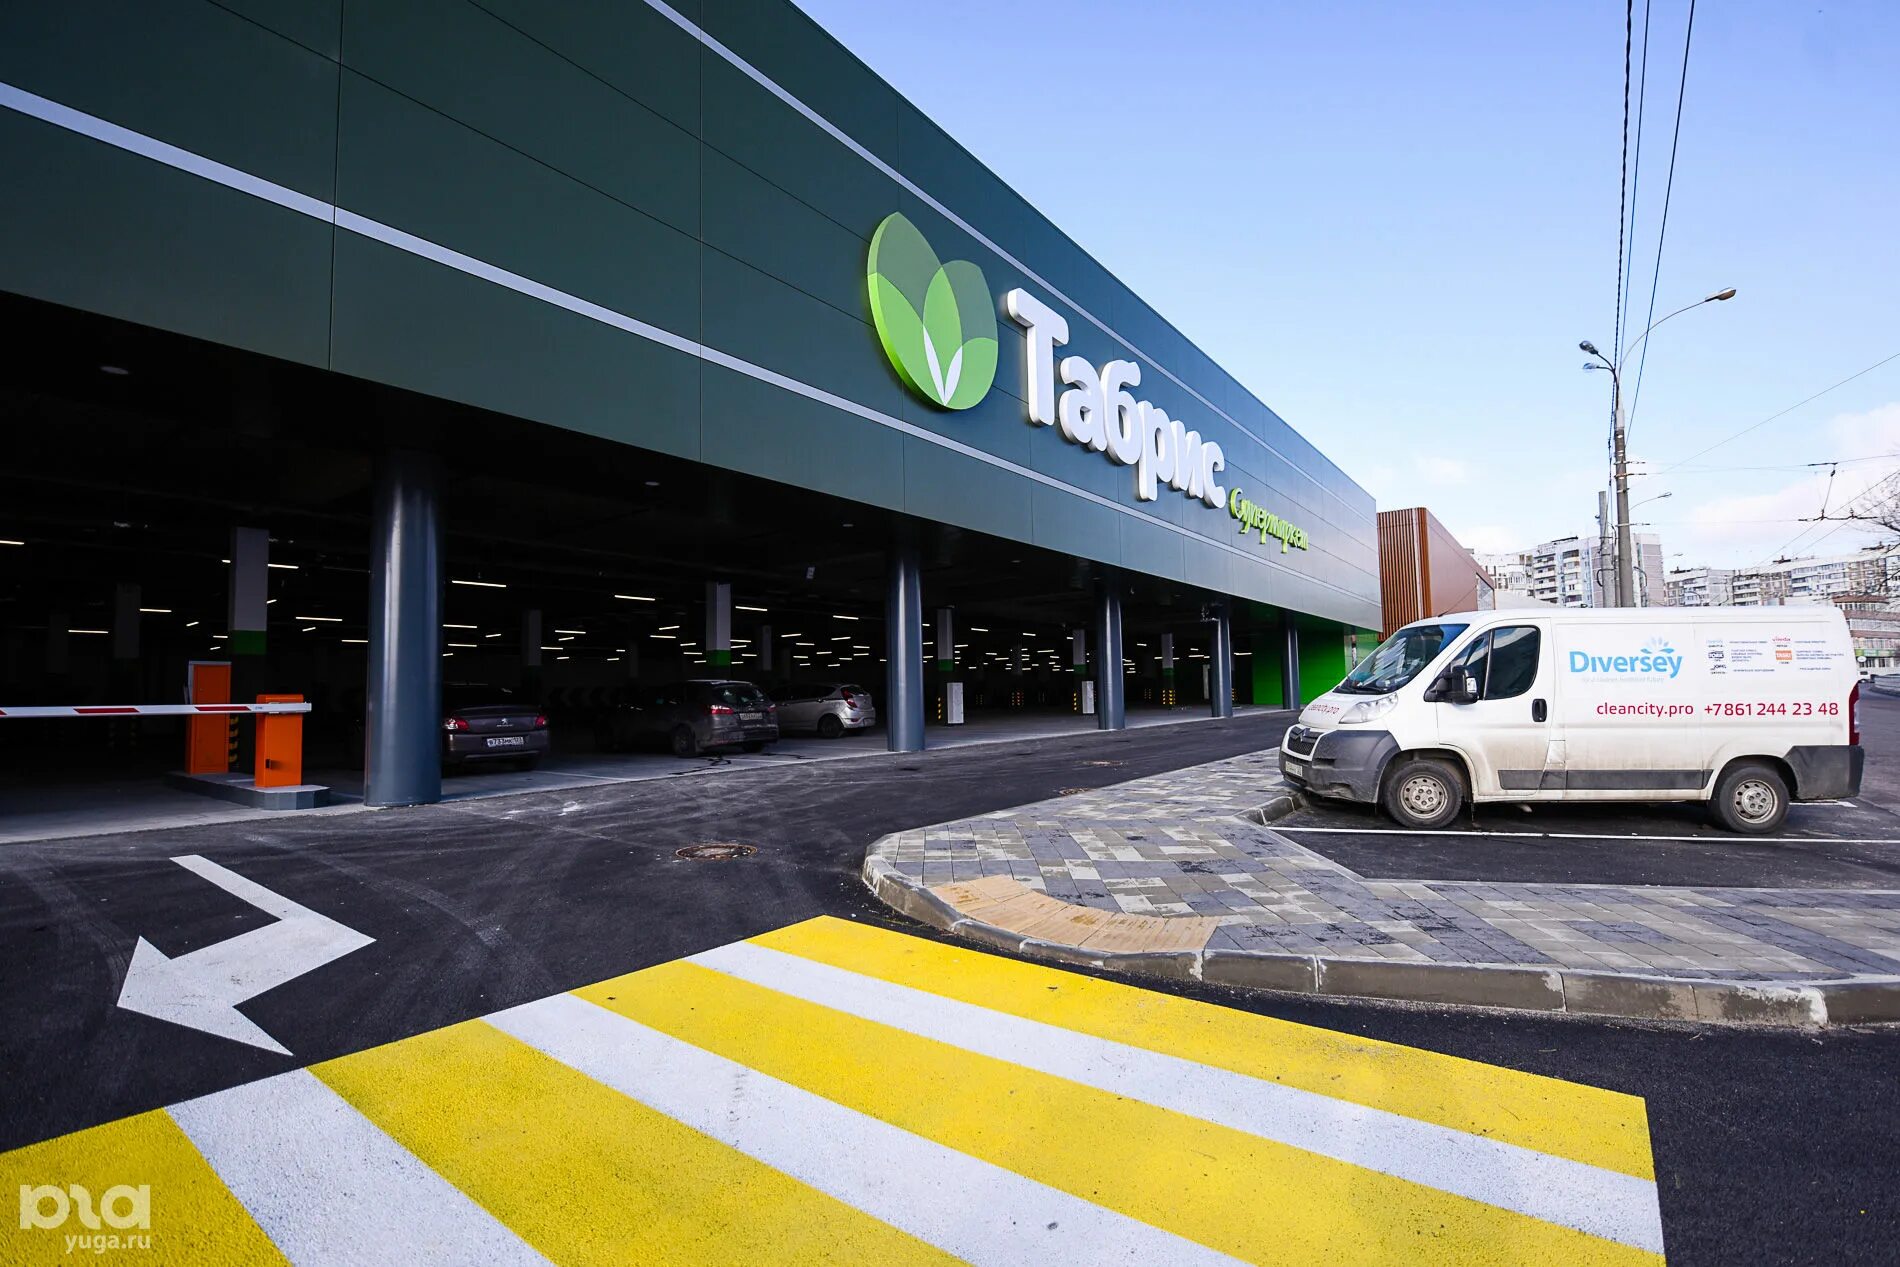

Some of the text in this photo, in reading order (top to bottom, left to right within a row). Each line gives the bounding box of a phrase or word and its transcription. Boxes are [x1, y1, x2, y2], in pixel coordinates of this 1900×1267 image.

[1007, 287, 1225, 509] Табрис
[1569, 650, 1683, 679] Diversey
[1596, 702, 1694, 718] cleancity.pro
[1756, 703, 1787, 716] 244
[1792, 703, 1812, 716] 23
[1817, 703, 1839, 716] 48
